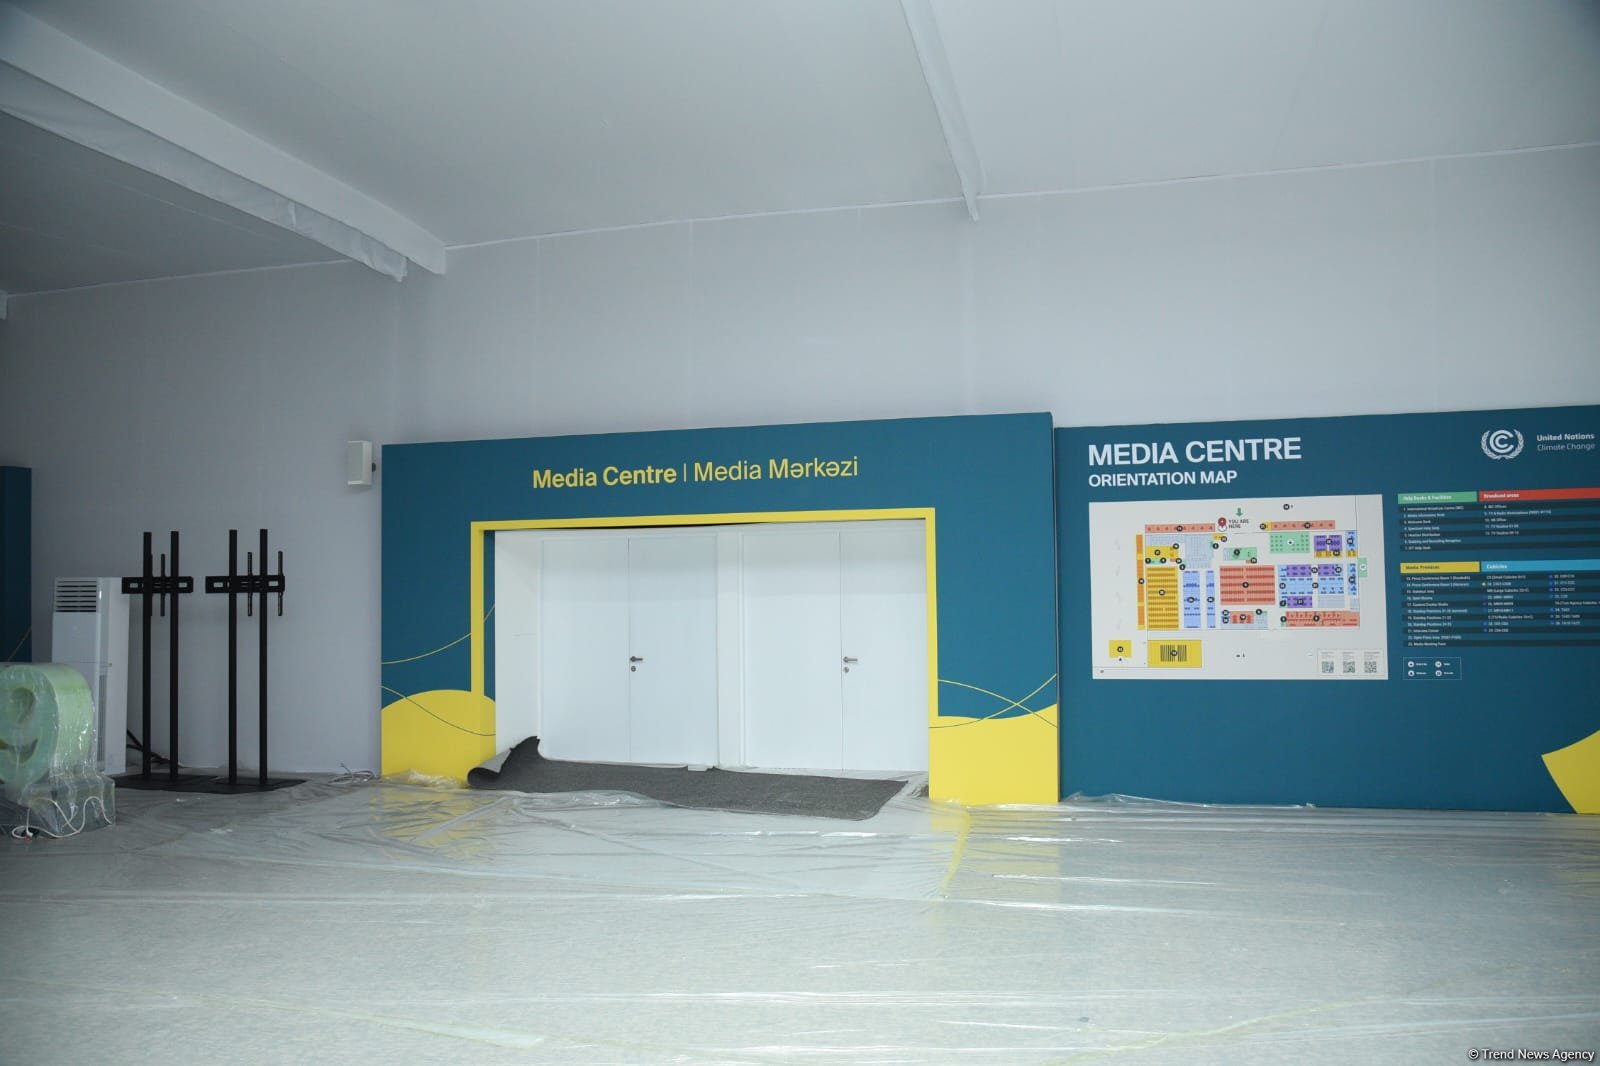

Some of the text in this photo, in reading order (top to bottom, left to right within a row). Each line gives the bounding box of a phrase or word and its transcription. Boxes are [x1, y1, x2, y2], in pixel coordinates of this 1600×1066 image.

[1536, 432, 1595, 441] United Nations
[1088, 437, 1302, 466] MEDIA CENTRE
[1537, 442, 1596, 451] Climate Change
[532, 468, 598, 489] Media
[602, 465, 677, 486] Centre
[694, 460, 762, 482] Media
[769, 456, 858, 479] Mərkəzi
[1088, 470, 1238, 487] ORIENTATION MAP
